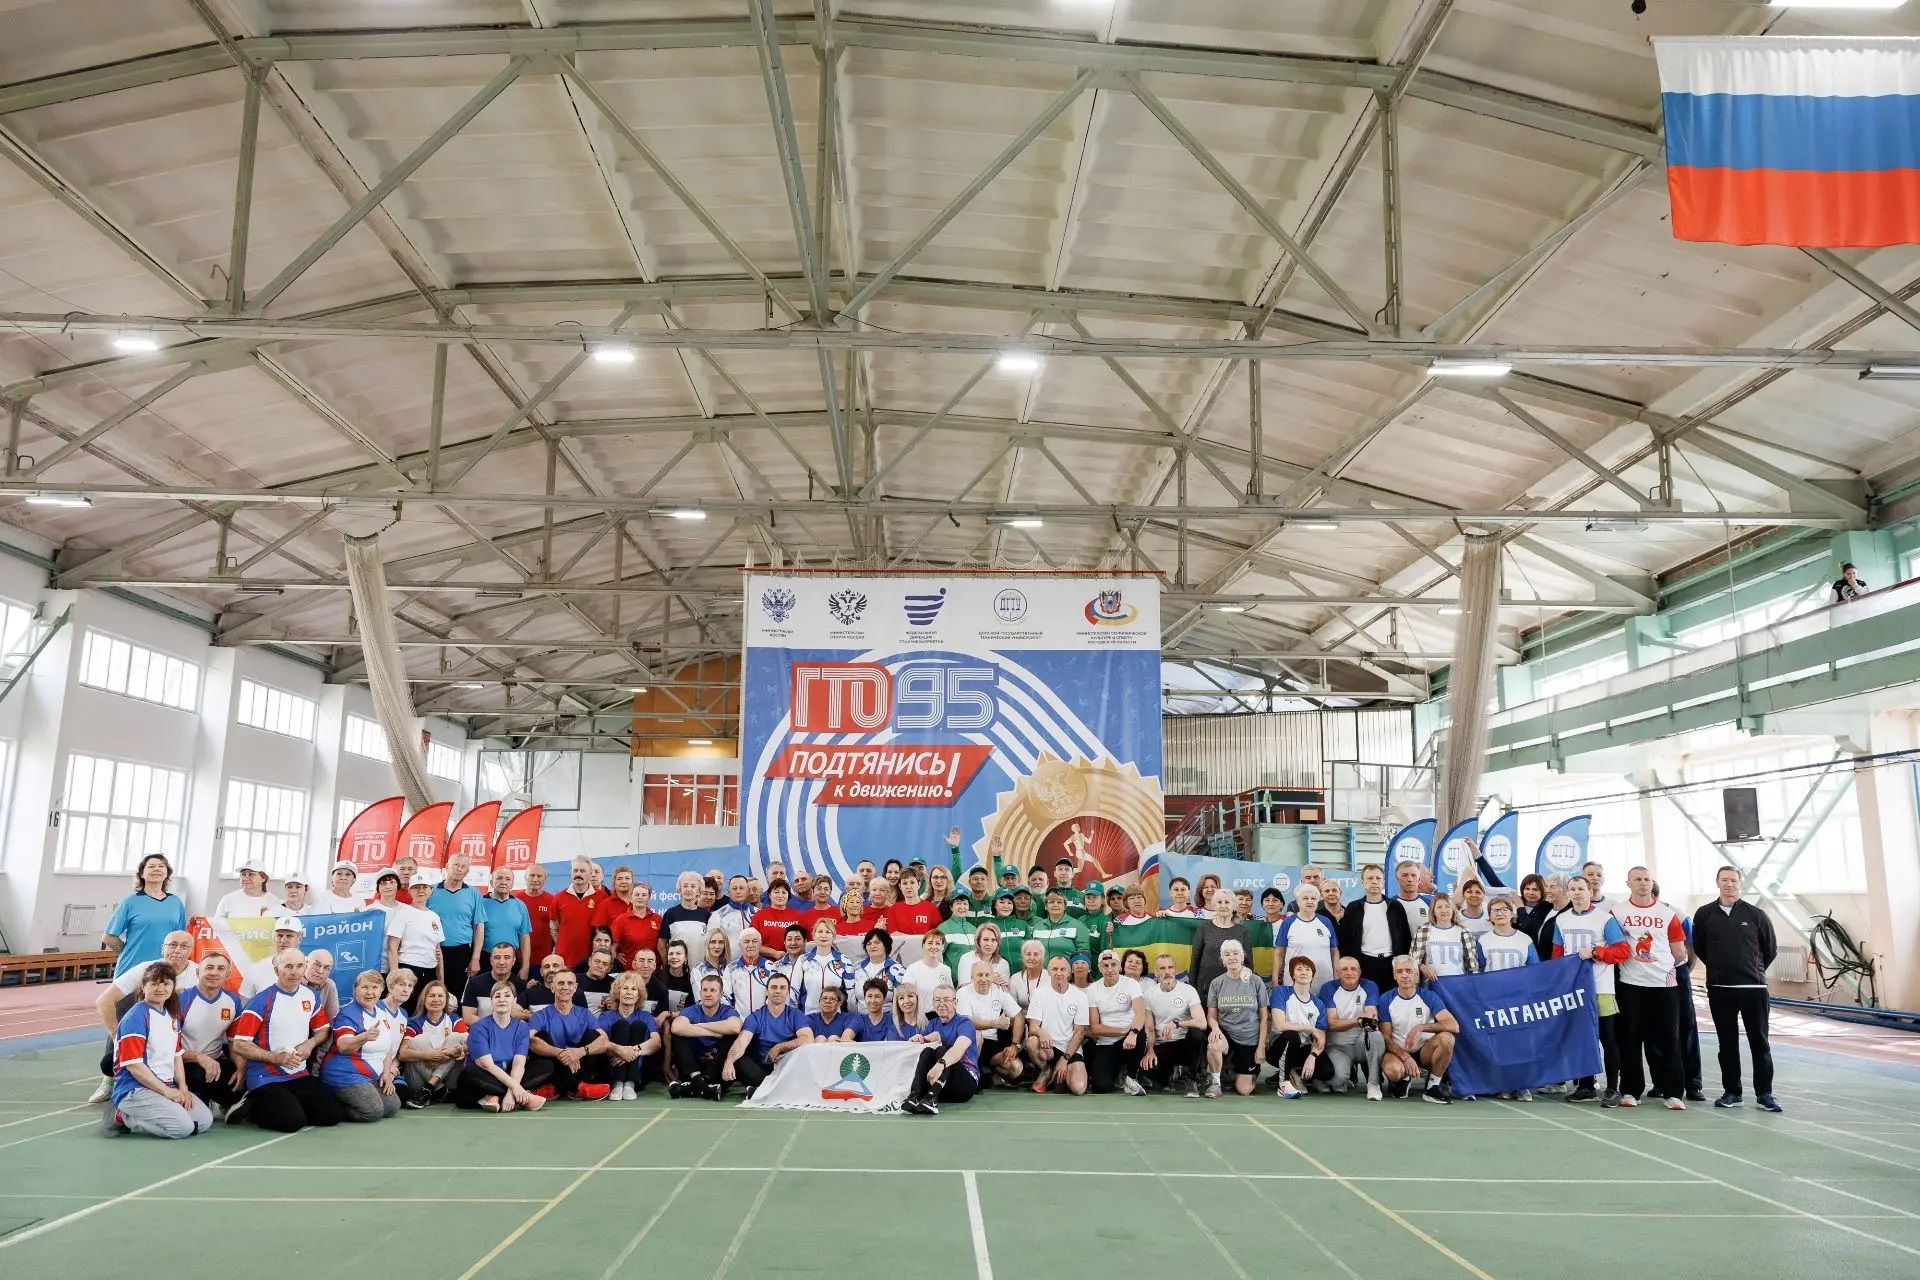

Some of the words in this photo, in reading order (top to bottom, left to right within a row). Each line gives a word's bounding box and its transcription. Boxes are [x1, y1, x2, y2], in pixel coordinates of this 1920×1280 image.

[48, 810, 60, 828] 16
[352, 840, 387, 863] ГТО
[408, 841, 436, 859] ГТО
[506, 845, 530, 863] ГТО
[314, 920, 374, 940] район
[1622, 915, 1664, 929] АЗОВ
[1485, 988, 1585, 1028] ТАГАНРОГ
